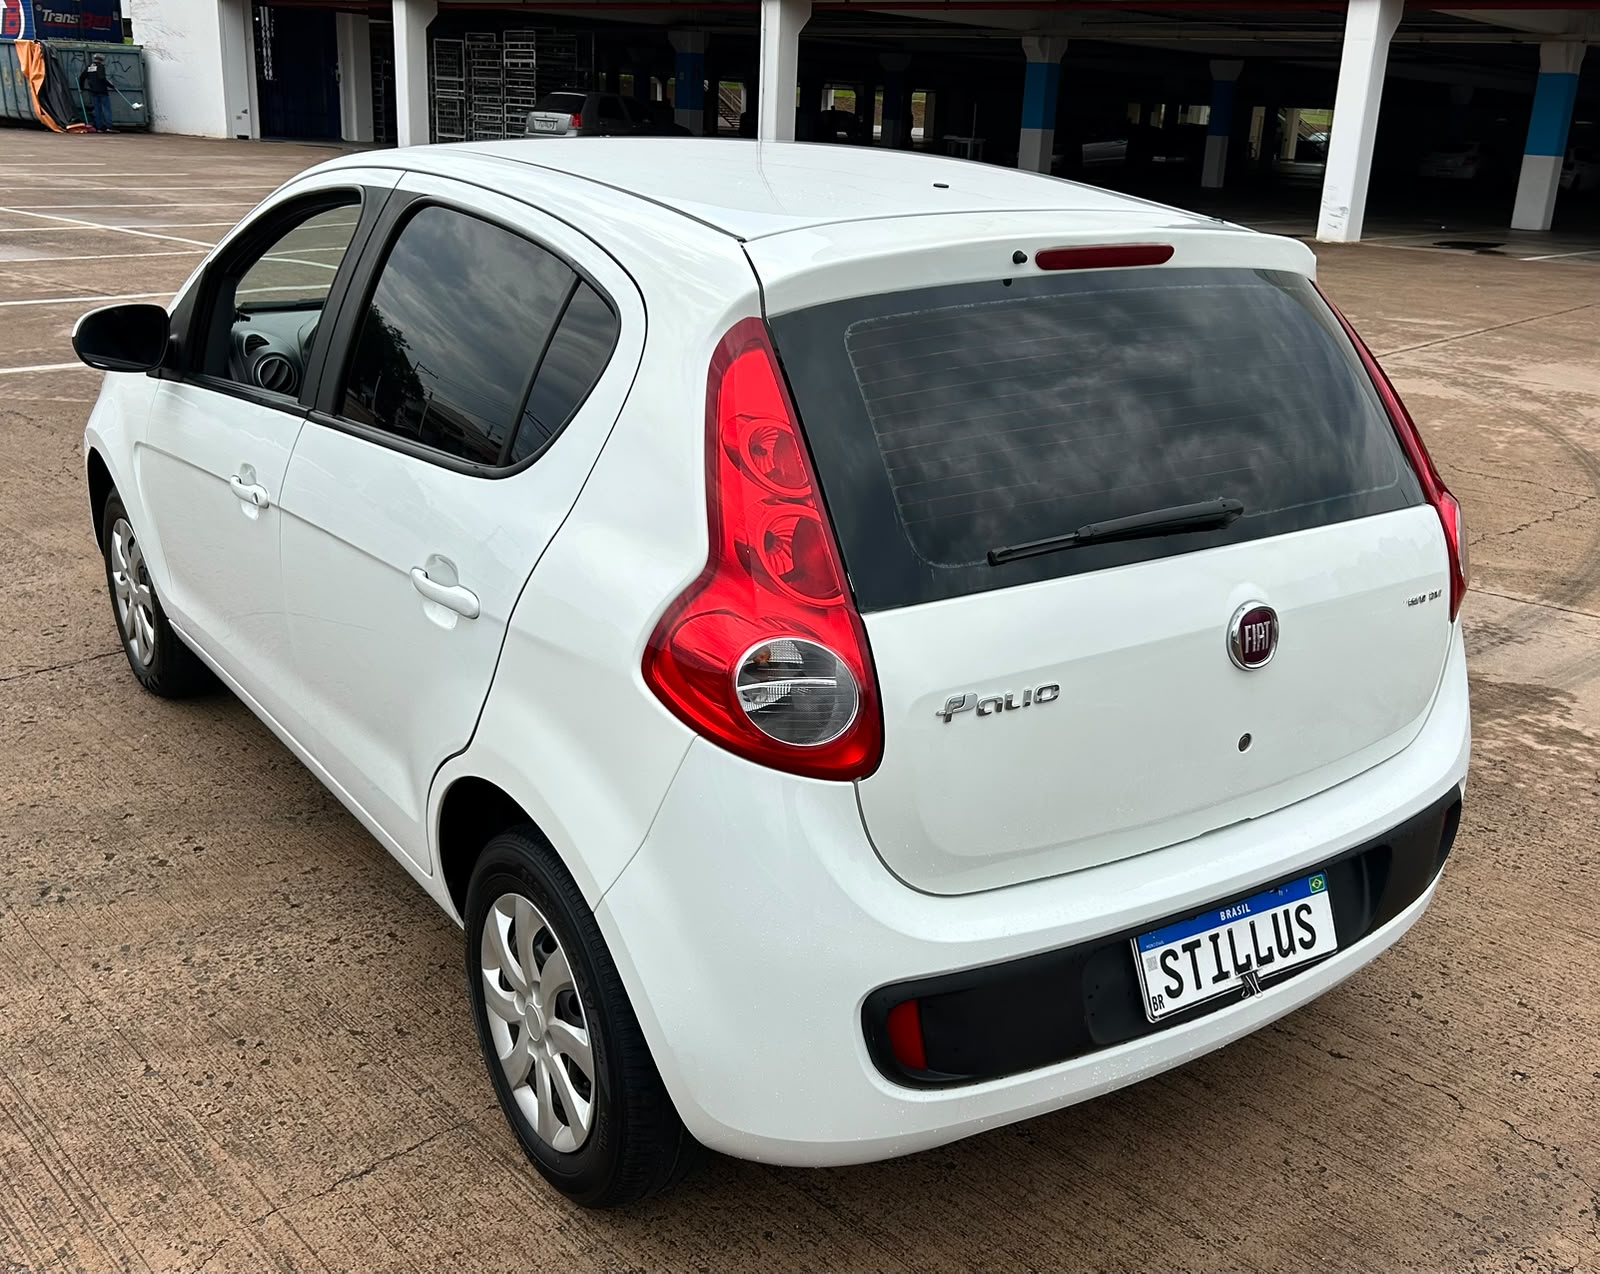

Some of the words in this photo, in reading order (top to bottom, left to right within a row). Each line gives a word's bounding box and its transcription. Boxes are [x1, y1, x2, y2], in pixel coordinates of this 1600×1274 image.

[1244, 620, 1271, 654] FIAT
[1219, 903, 1251, 921] BRASIL
[1159, 903, 1317, 999] STILLUS
[1151, 993, 1166, 1012] BR
